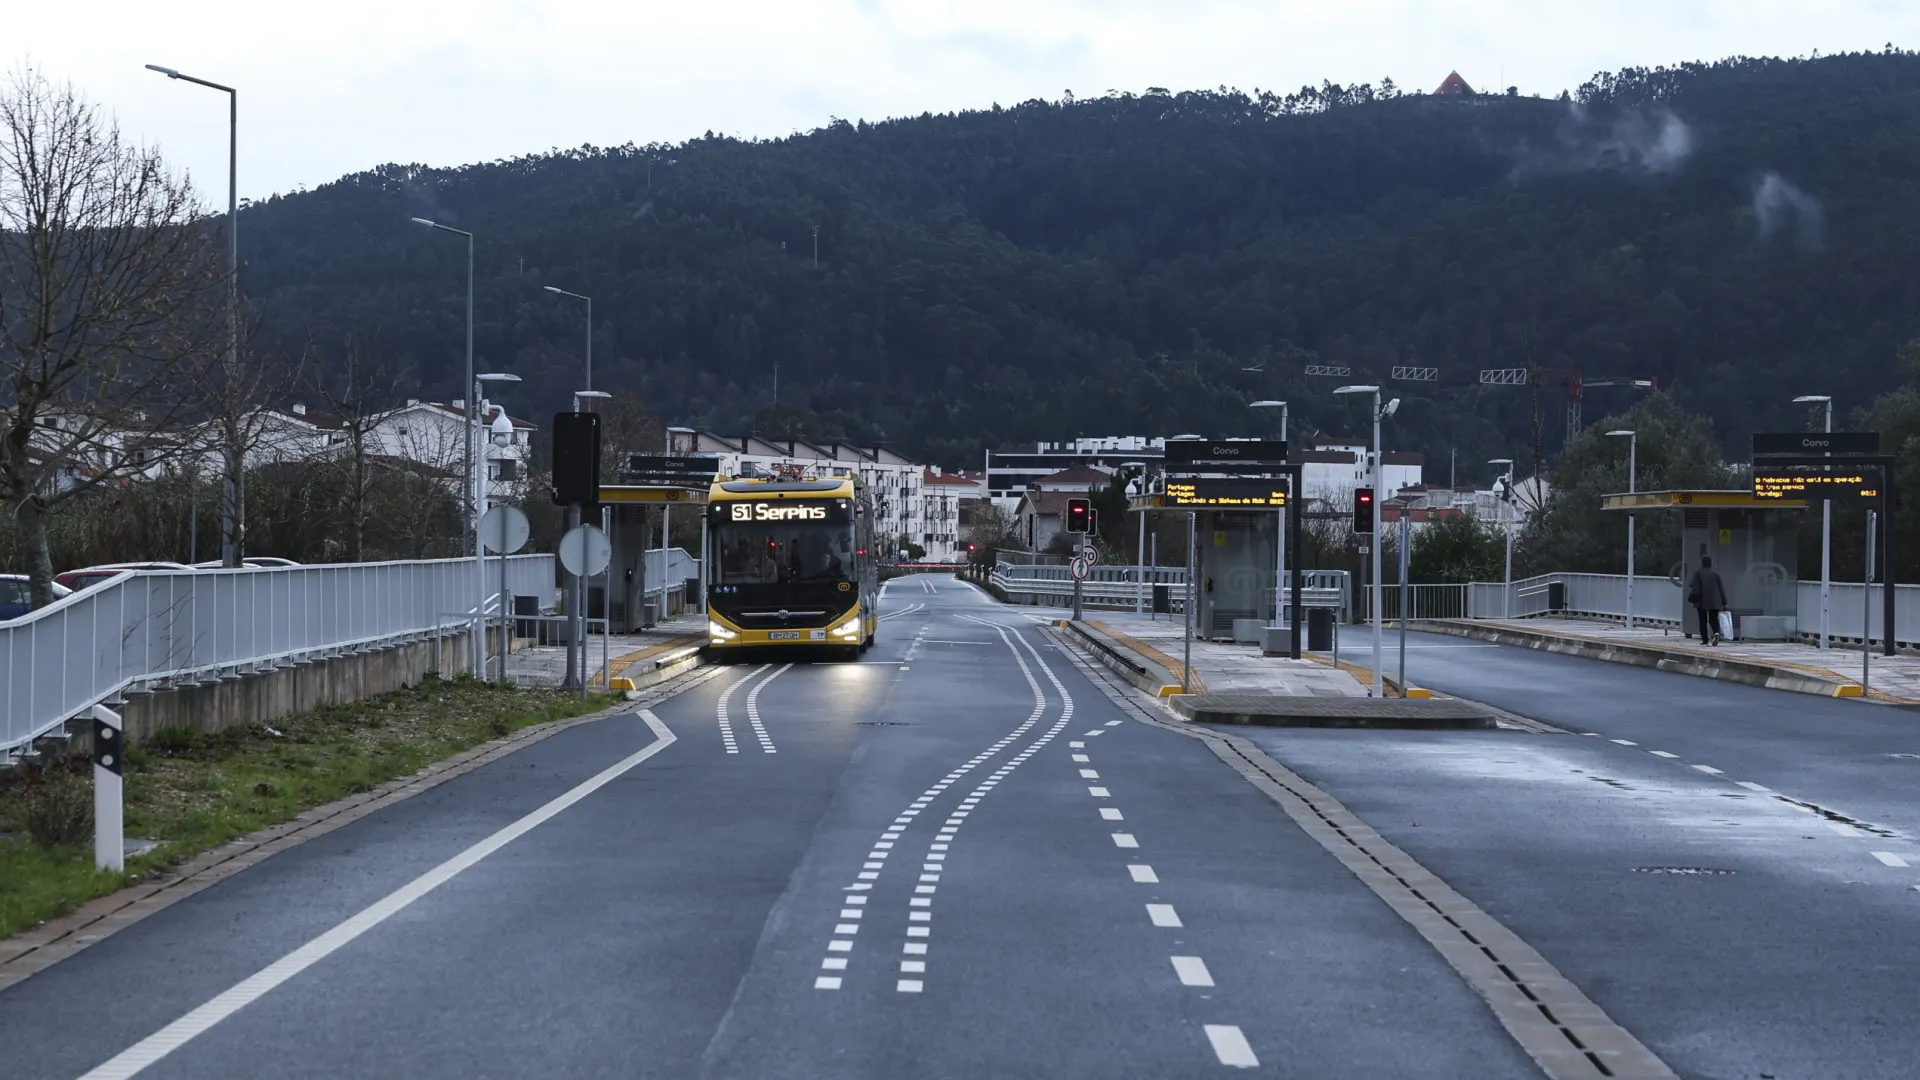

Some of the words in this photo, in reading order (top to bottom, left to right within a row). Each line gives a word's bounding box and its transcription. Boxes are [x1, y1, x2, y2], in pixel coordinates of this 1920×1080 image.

[1802, 438, 1829, 447] Corvo
[1213, 446, 1239, 455] Corvo
[732, 504, 751, 520] S1
[755, 503, 826, 520] Serpins
